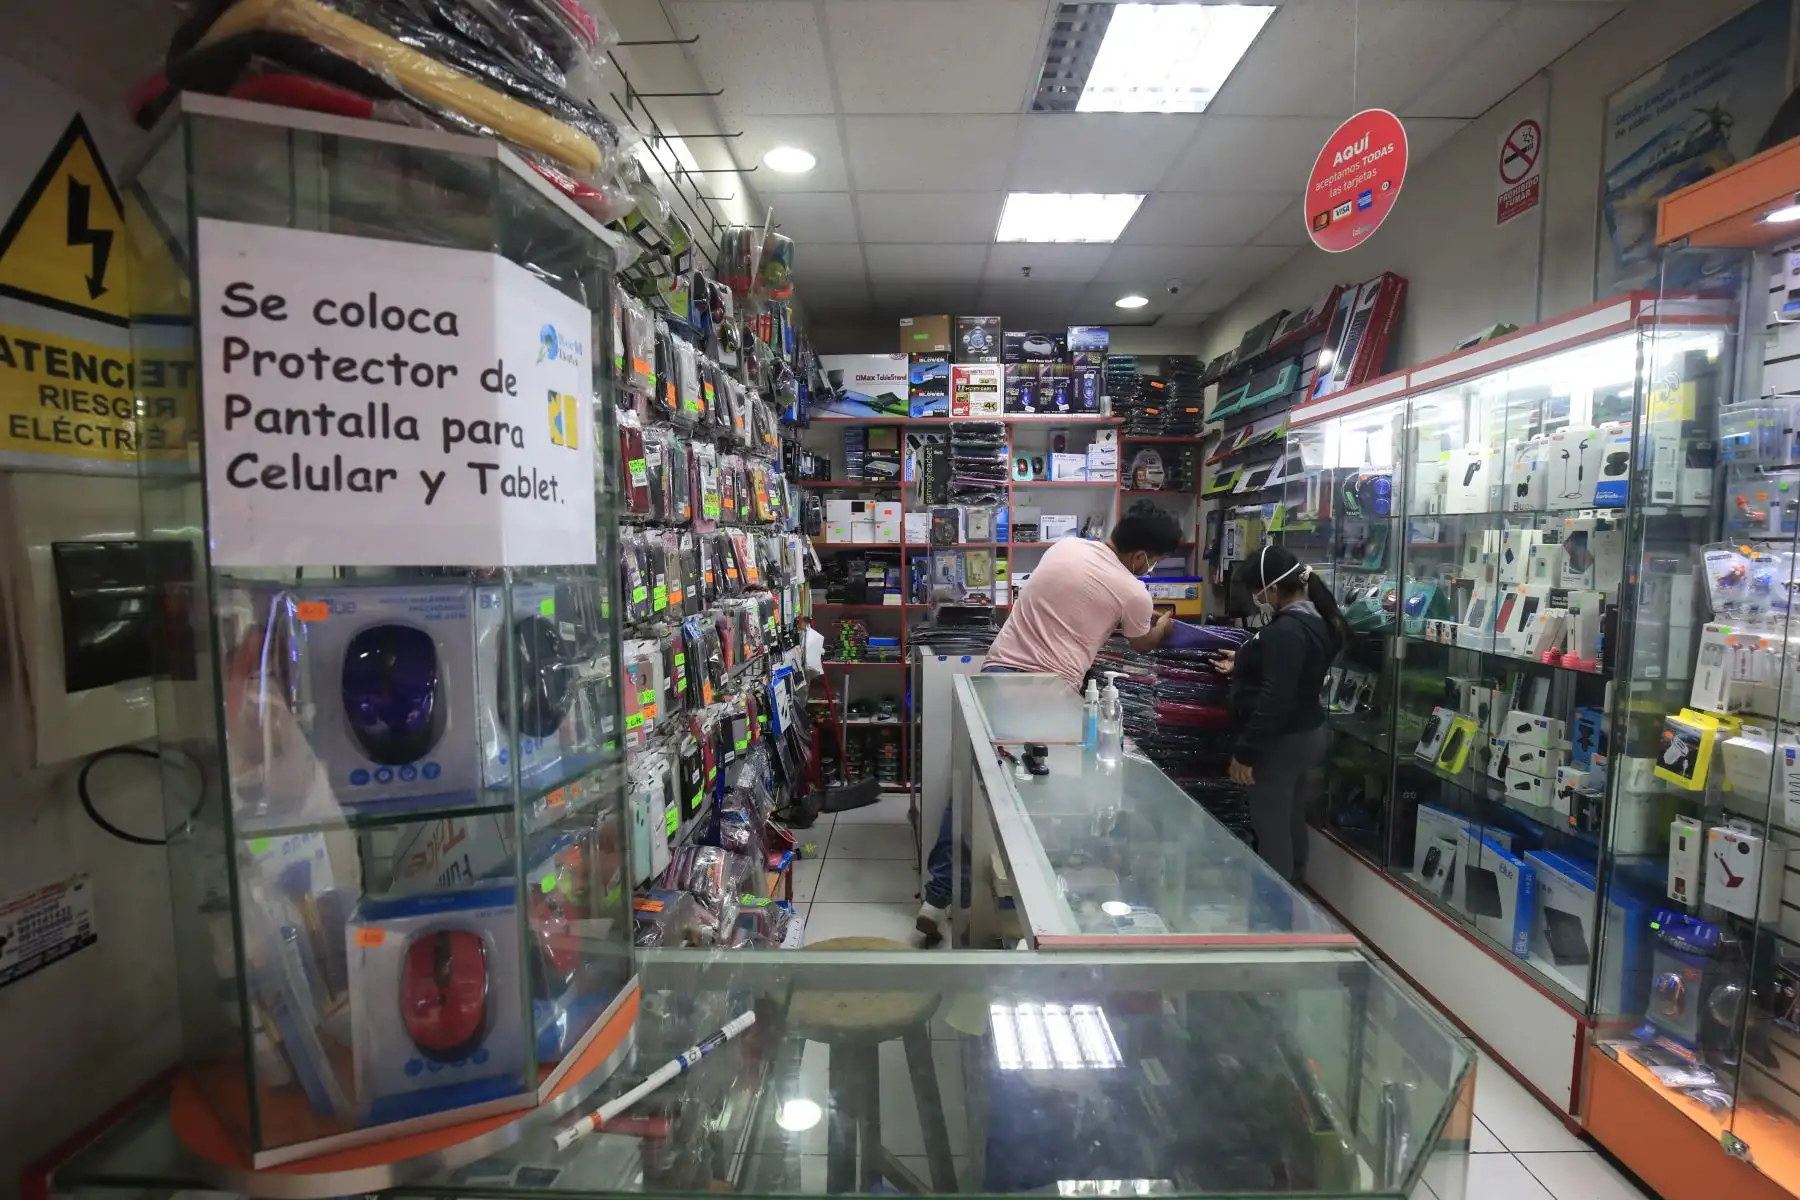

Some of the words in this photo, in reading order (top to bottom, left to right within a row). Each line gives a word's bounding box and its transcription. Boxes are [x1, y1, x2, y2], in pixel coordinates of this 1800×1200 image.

[1333, 131, 1371, 167] AQUÍ
[1315, 161, 1360, 191] aceptamos
[1361, 143, 1394, 166] TODAS
[1328, 186, 1342, 199] las
[1343, 168, 1377, 190] tarjetas
[1499, 177, 1539, 204] PROHIBIDO
[1505, 189, 1531, 209] FUMAR
[1335, 205, 1350, 217] VISA
[220, 282, 288, 322] Se
[312, 291, 459, 337] coloca
[222, 336, 458, 389] Protector
[480, 357, 518, 398] de
[984, 402, 997, 410] 4K
[225, 394, 420, 442] Pantalla
[442, 416, 525, 453] para
[226, 452, 398, 493] Celular
[419, 469, 446, 506] y
[467, 461, 565, 504] Tablet.
[1515, 931, 1528, 954] iBlue
